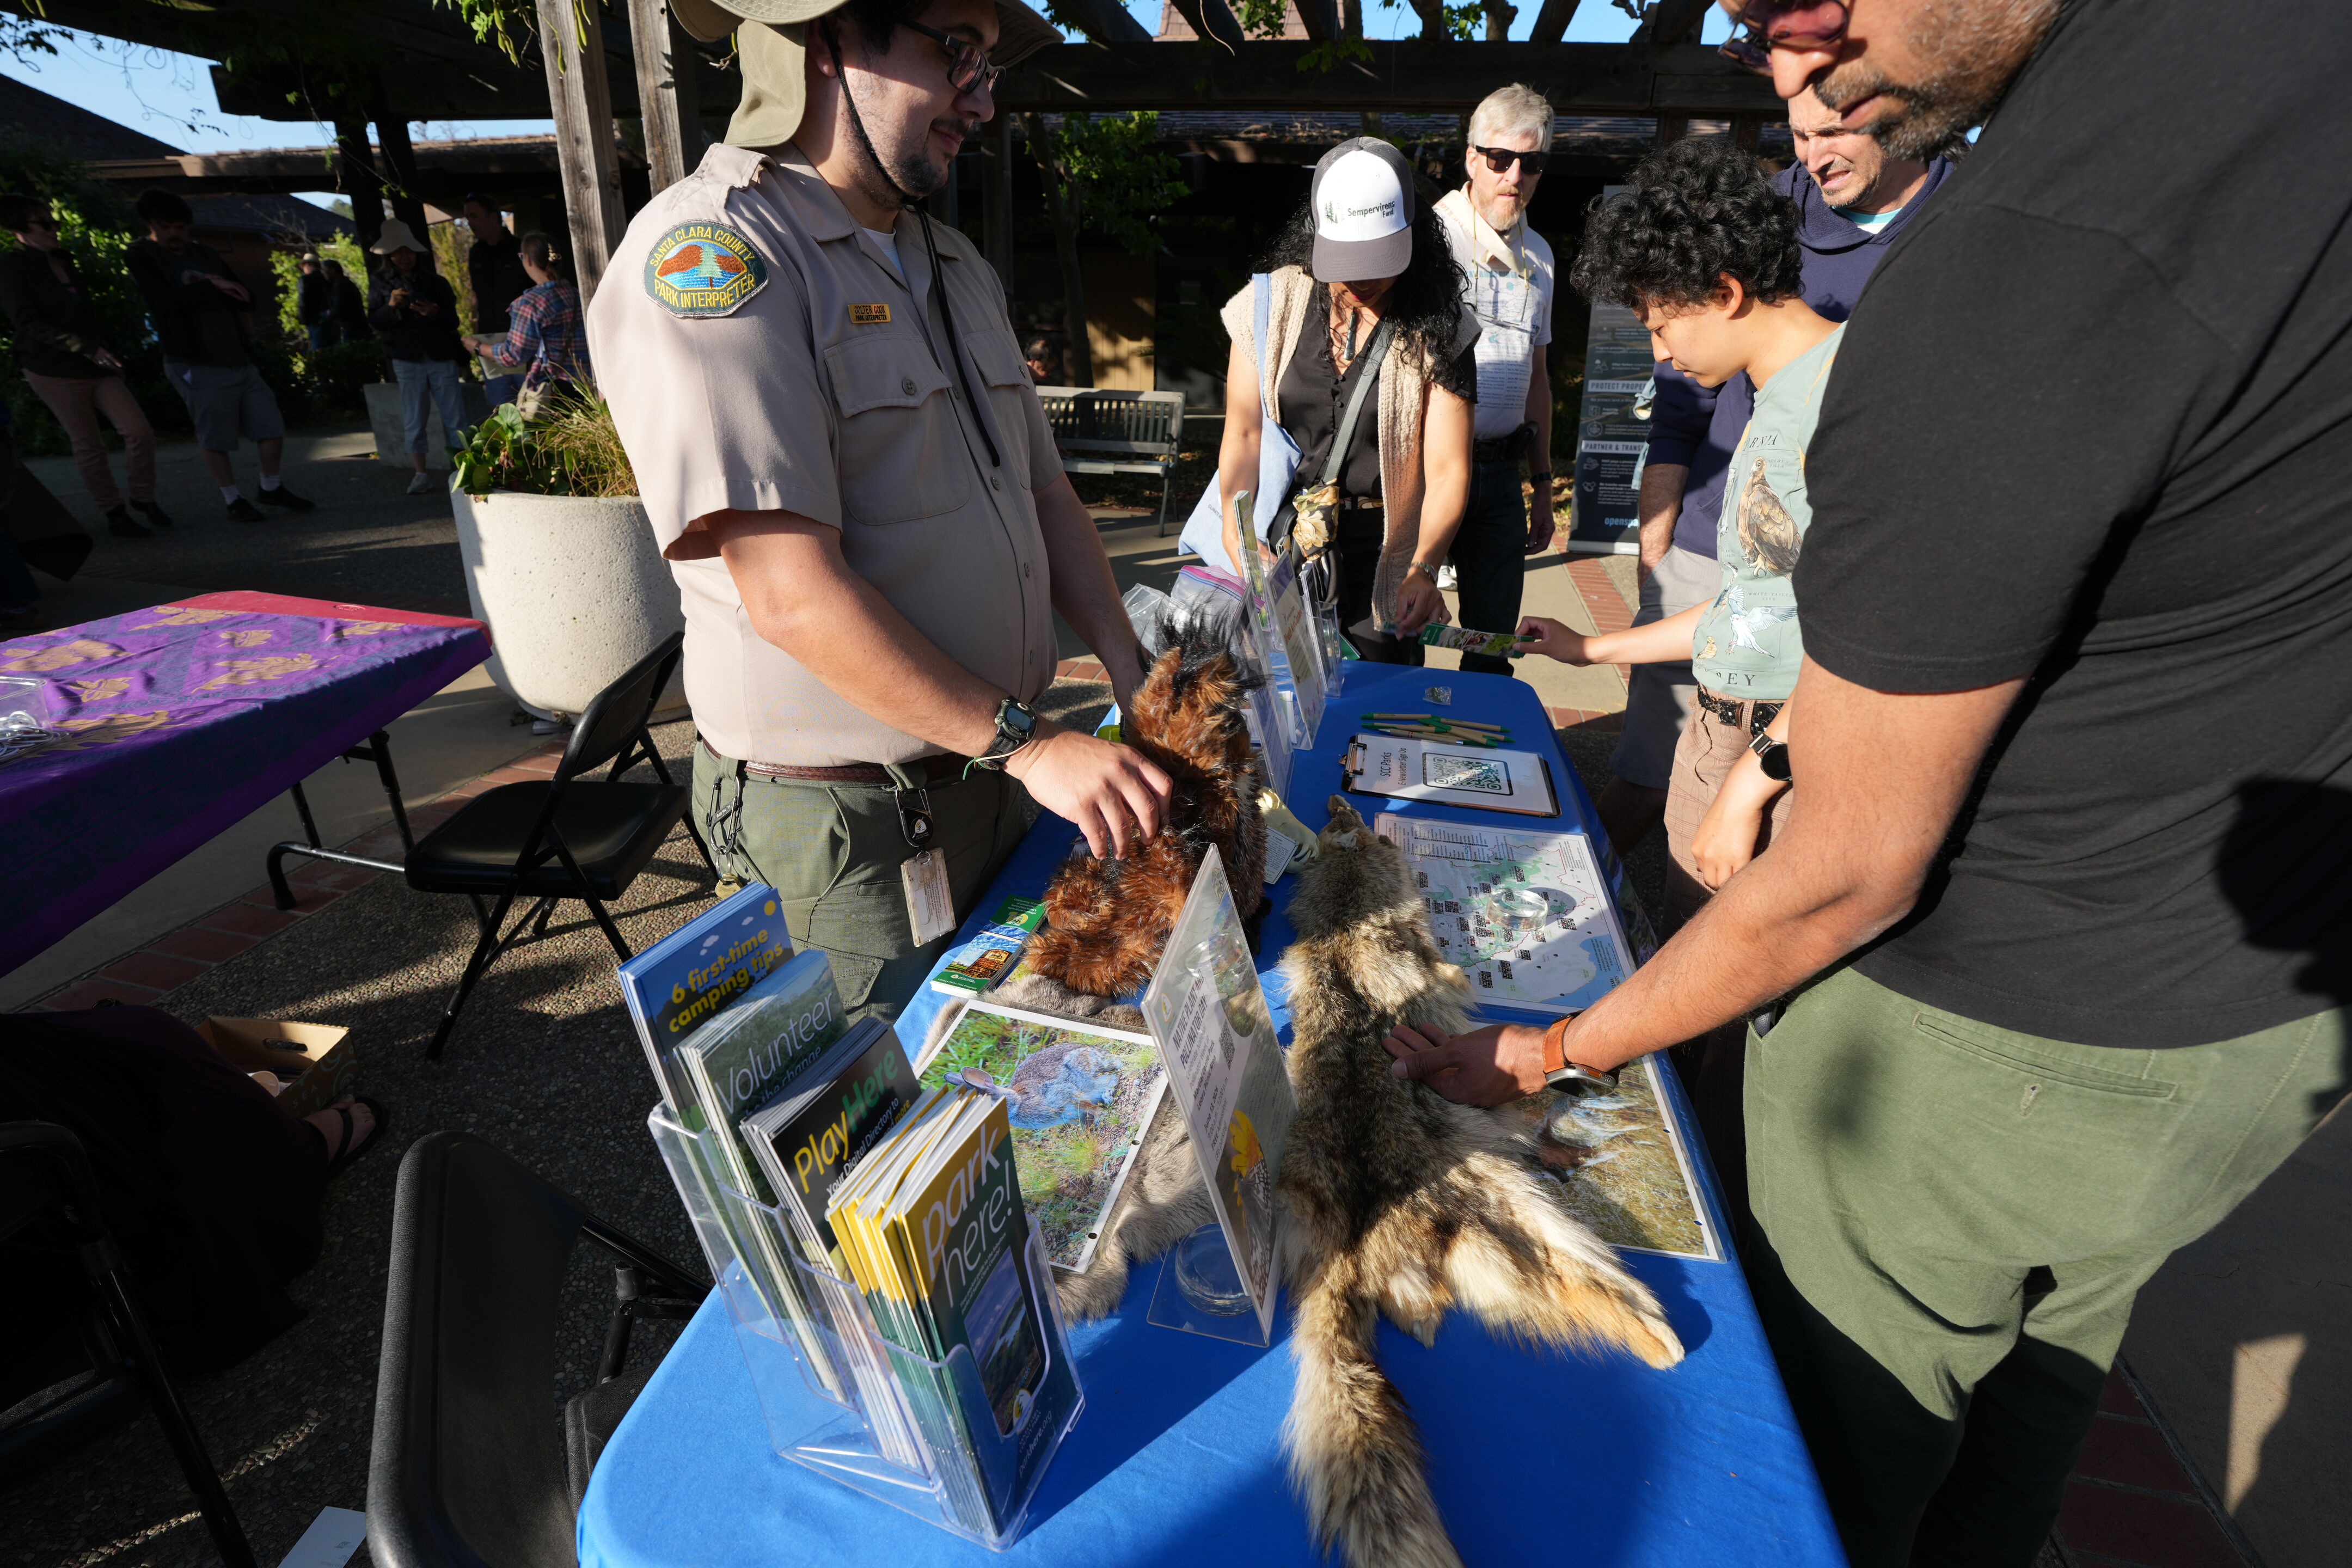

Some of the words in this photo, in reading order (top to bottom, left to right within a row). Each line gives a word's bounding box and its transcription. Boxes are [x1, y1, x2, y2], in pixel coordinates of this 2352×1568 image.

[1347, 201, 1395, 217] Sempervirens
[1382, 208, 1394, 218] Fund
[650, 237, 676, 266] SANTA
[675, 226, 712, 241] CLARA
[715, 230, 755, 261] COUNTY
[654, 279, 679, 308] PARK
[681, 274, 755, 308] INTERPRETER
[854, 305, 872, 314] COLTER
[874, 305, 886, 314] COOK
[1591, 382, 1620, 390] PROTECT
[1380, 766, 1391, 777] SCC
[1381, 752, 1392, 765] Parks
[1398, 762, 1406, 785] E-Newsletter
[672, 983, 685, 1004] 6
[688, 929, 769, 992] first-time
[669, 967, 750, 1033] camping
[751, 942, 783, 973] tips
[1172, 1009, 1188, 1052] NATIVE
[1184, 983, 1198, 1021] PLANT
[1180, 1008, 1202, 1071] POLLINATOR
[1198, 992, 1208, 1020] DAY
[714, 993, 832, 1114] Volunteer
[1193, 1071, 1203, 1103] Martial
[895, 1099, 910, 1124] more
[826, 1174, 845, 1197] Your
[843, 1147, 866, 1177] Digital
[865, 1106, 892, 1149] Directory
[891, 1098, 899, 1110] to
[922, 1123, 1000, 1283] park
[940, 1159, 1013, 1308] here!
[1019, 1410, 1052, 1479] parkhere.org
